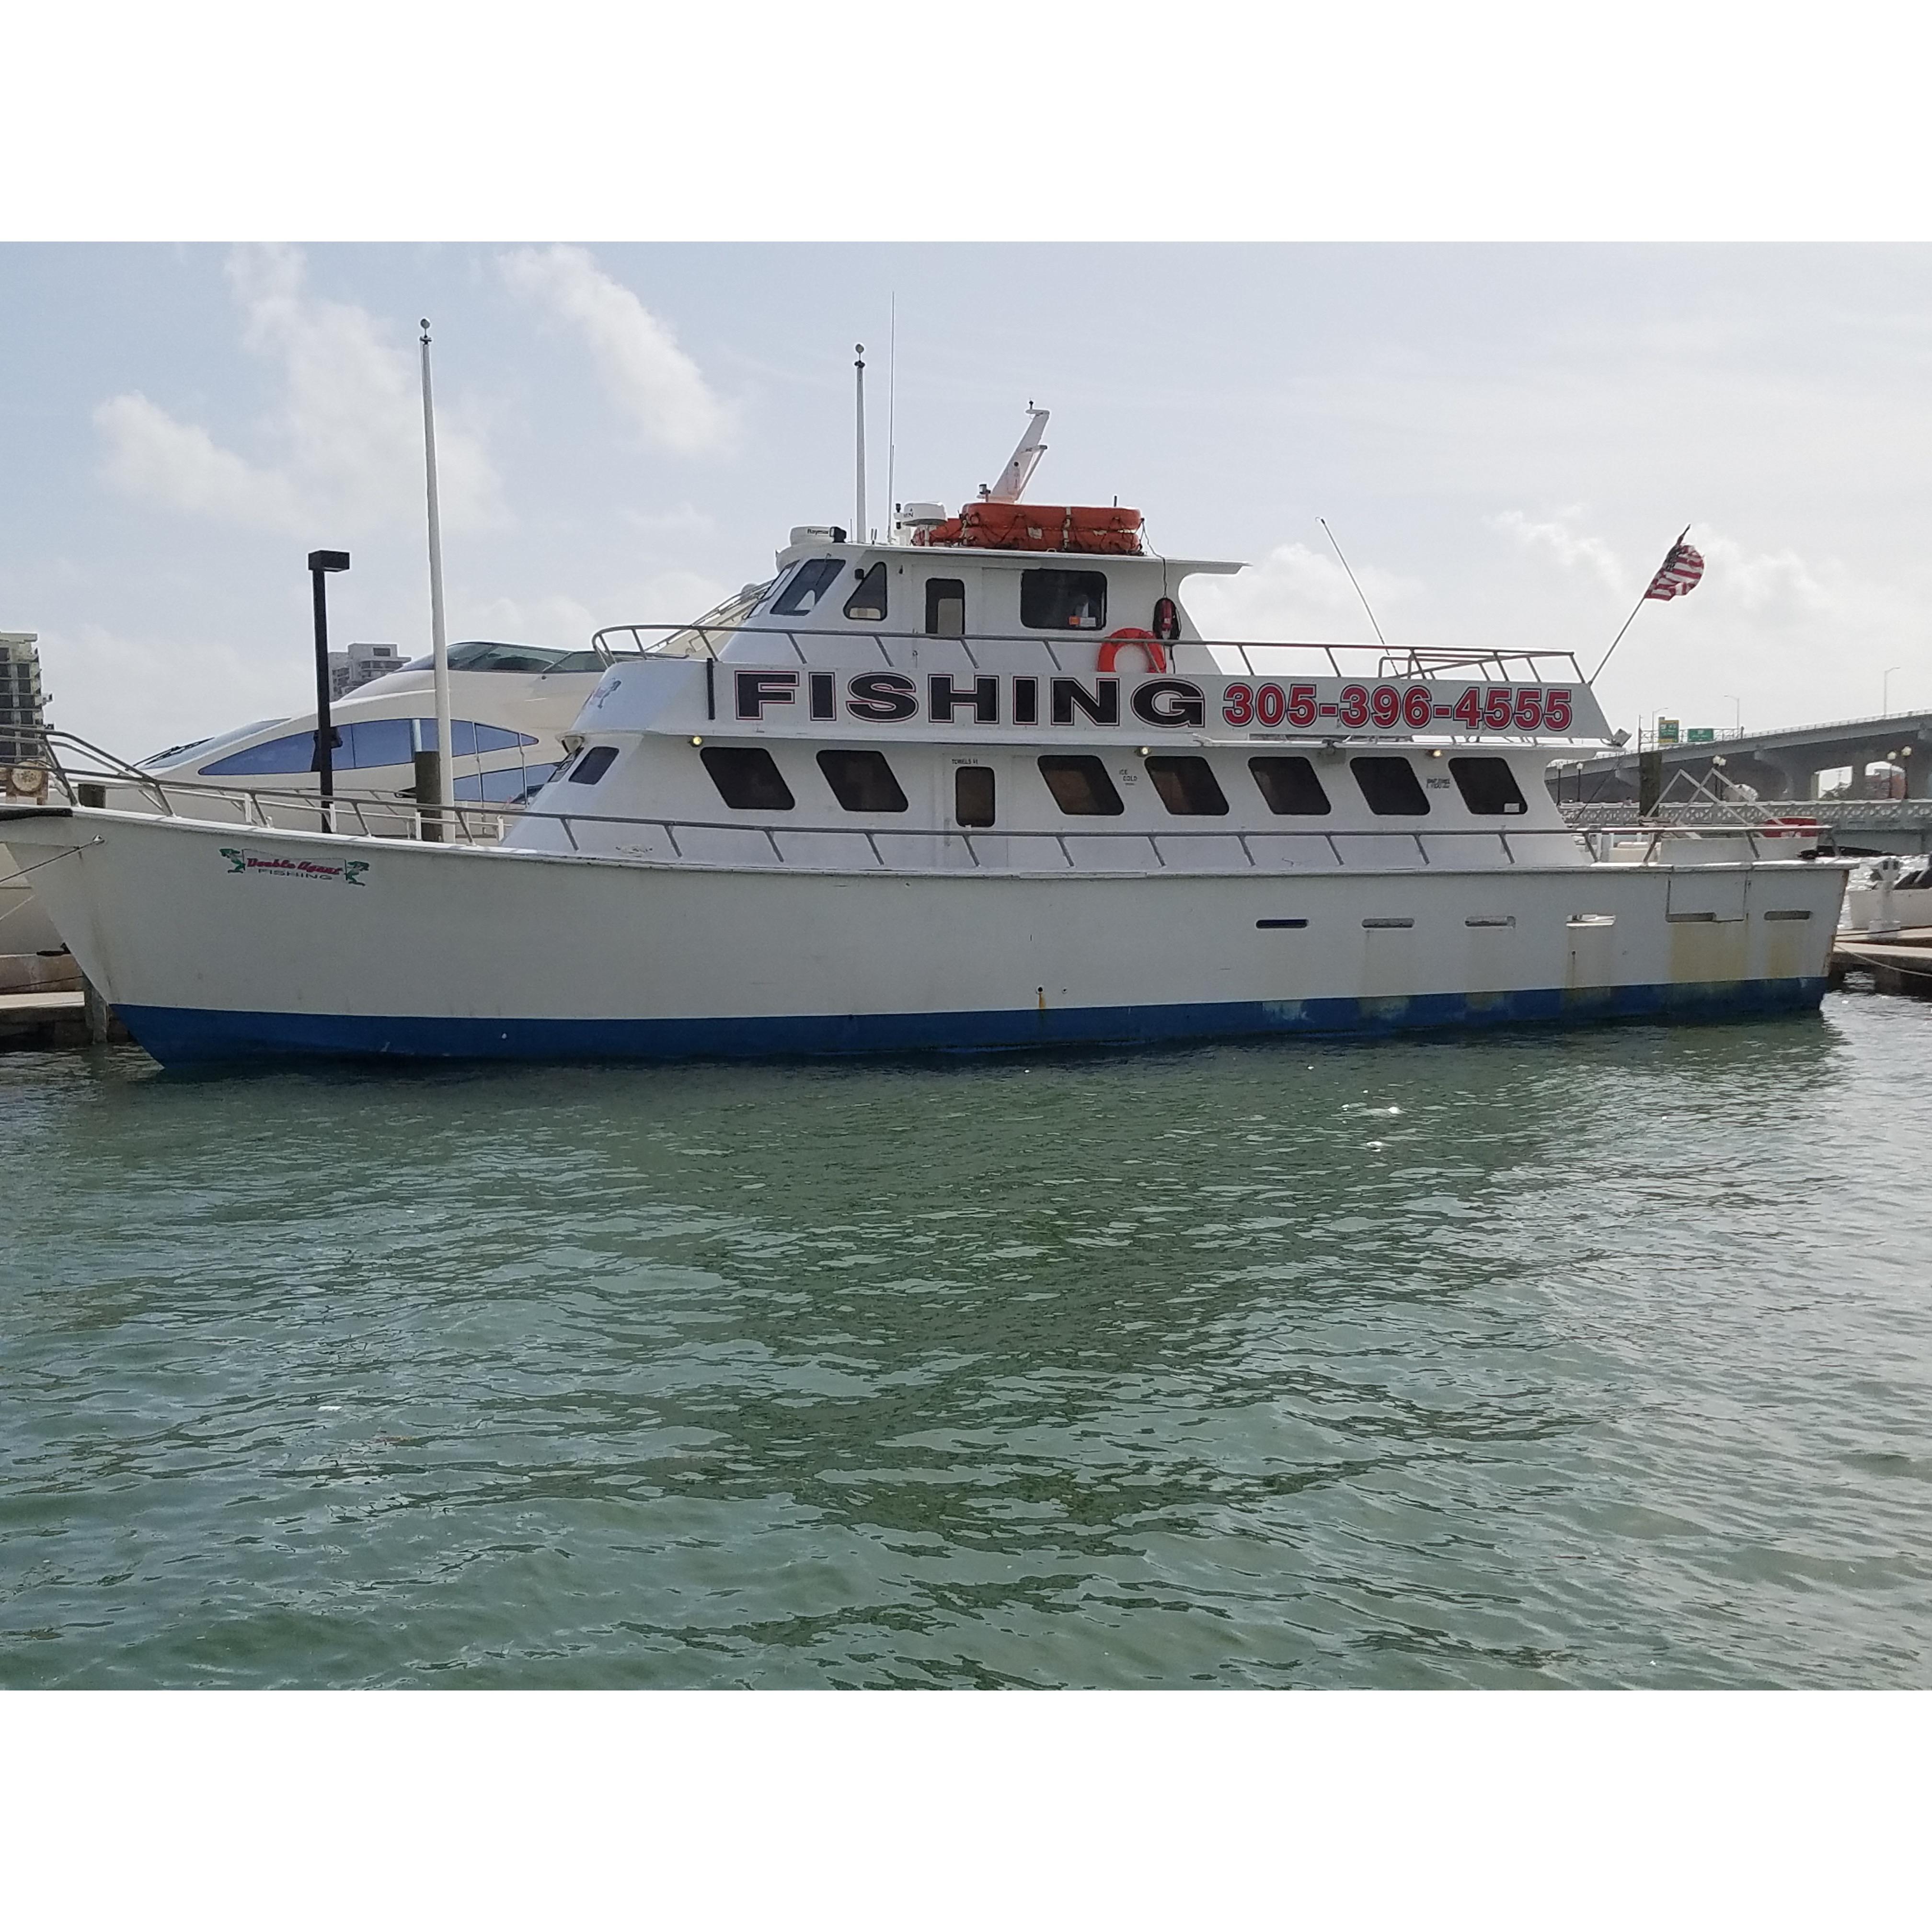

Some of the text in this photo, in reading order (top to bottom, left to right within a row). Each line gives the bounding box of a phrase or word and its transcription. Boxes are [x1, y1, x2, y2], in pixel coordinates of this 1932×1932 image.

[735, 670, 1572, 732] FISHING 305-396-4555
[247, 858, 296, 869] Double
[258, 868, 333, 880] FISHING
